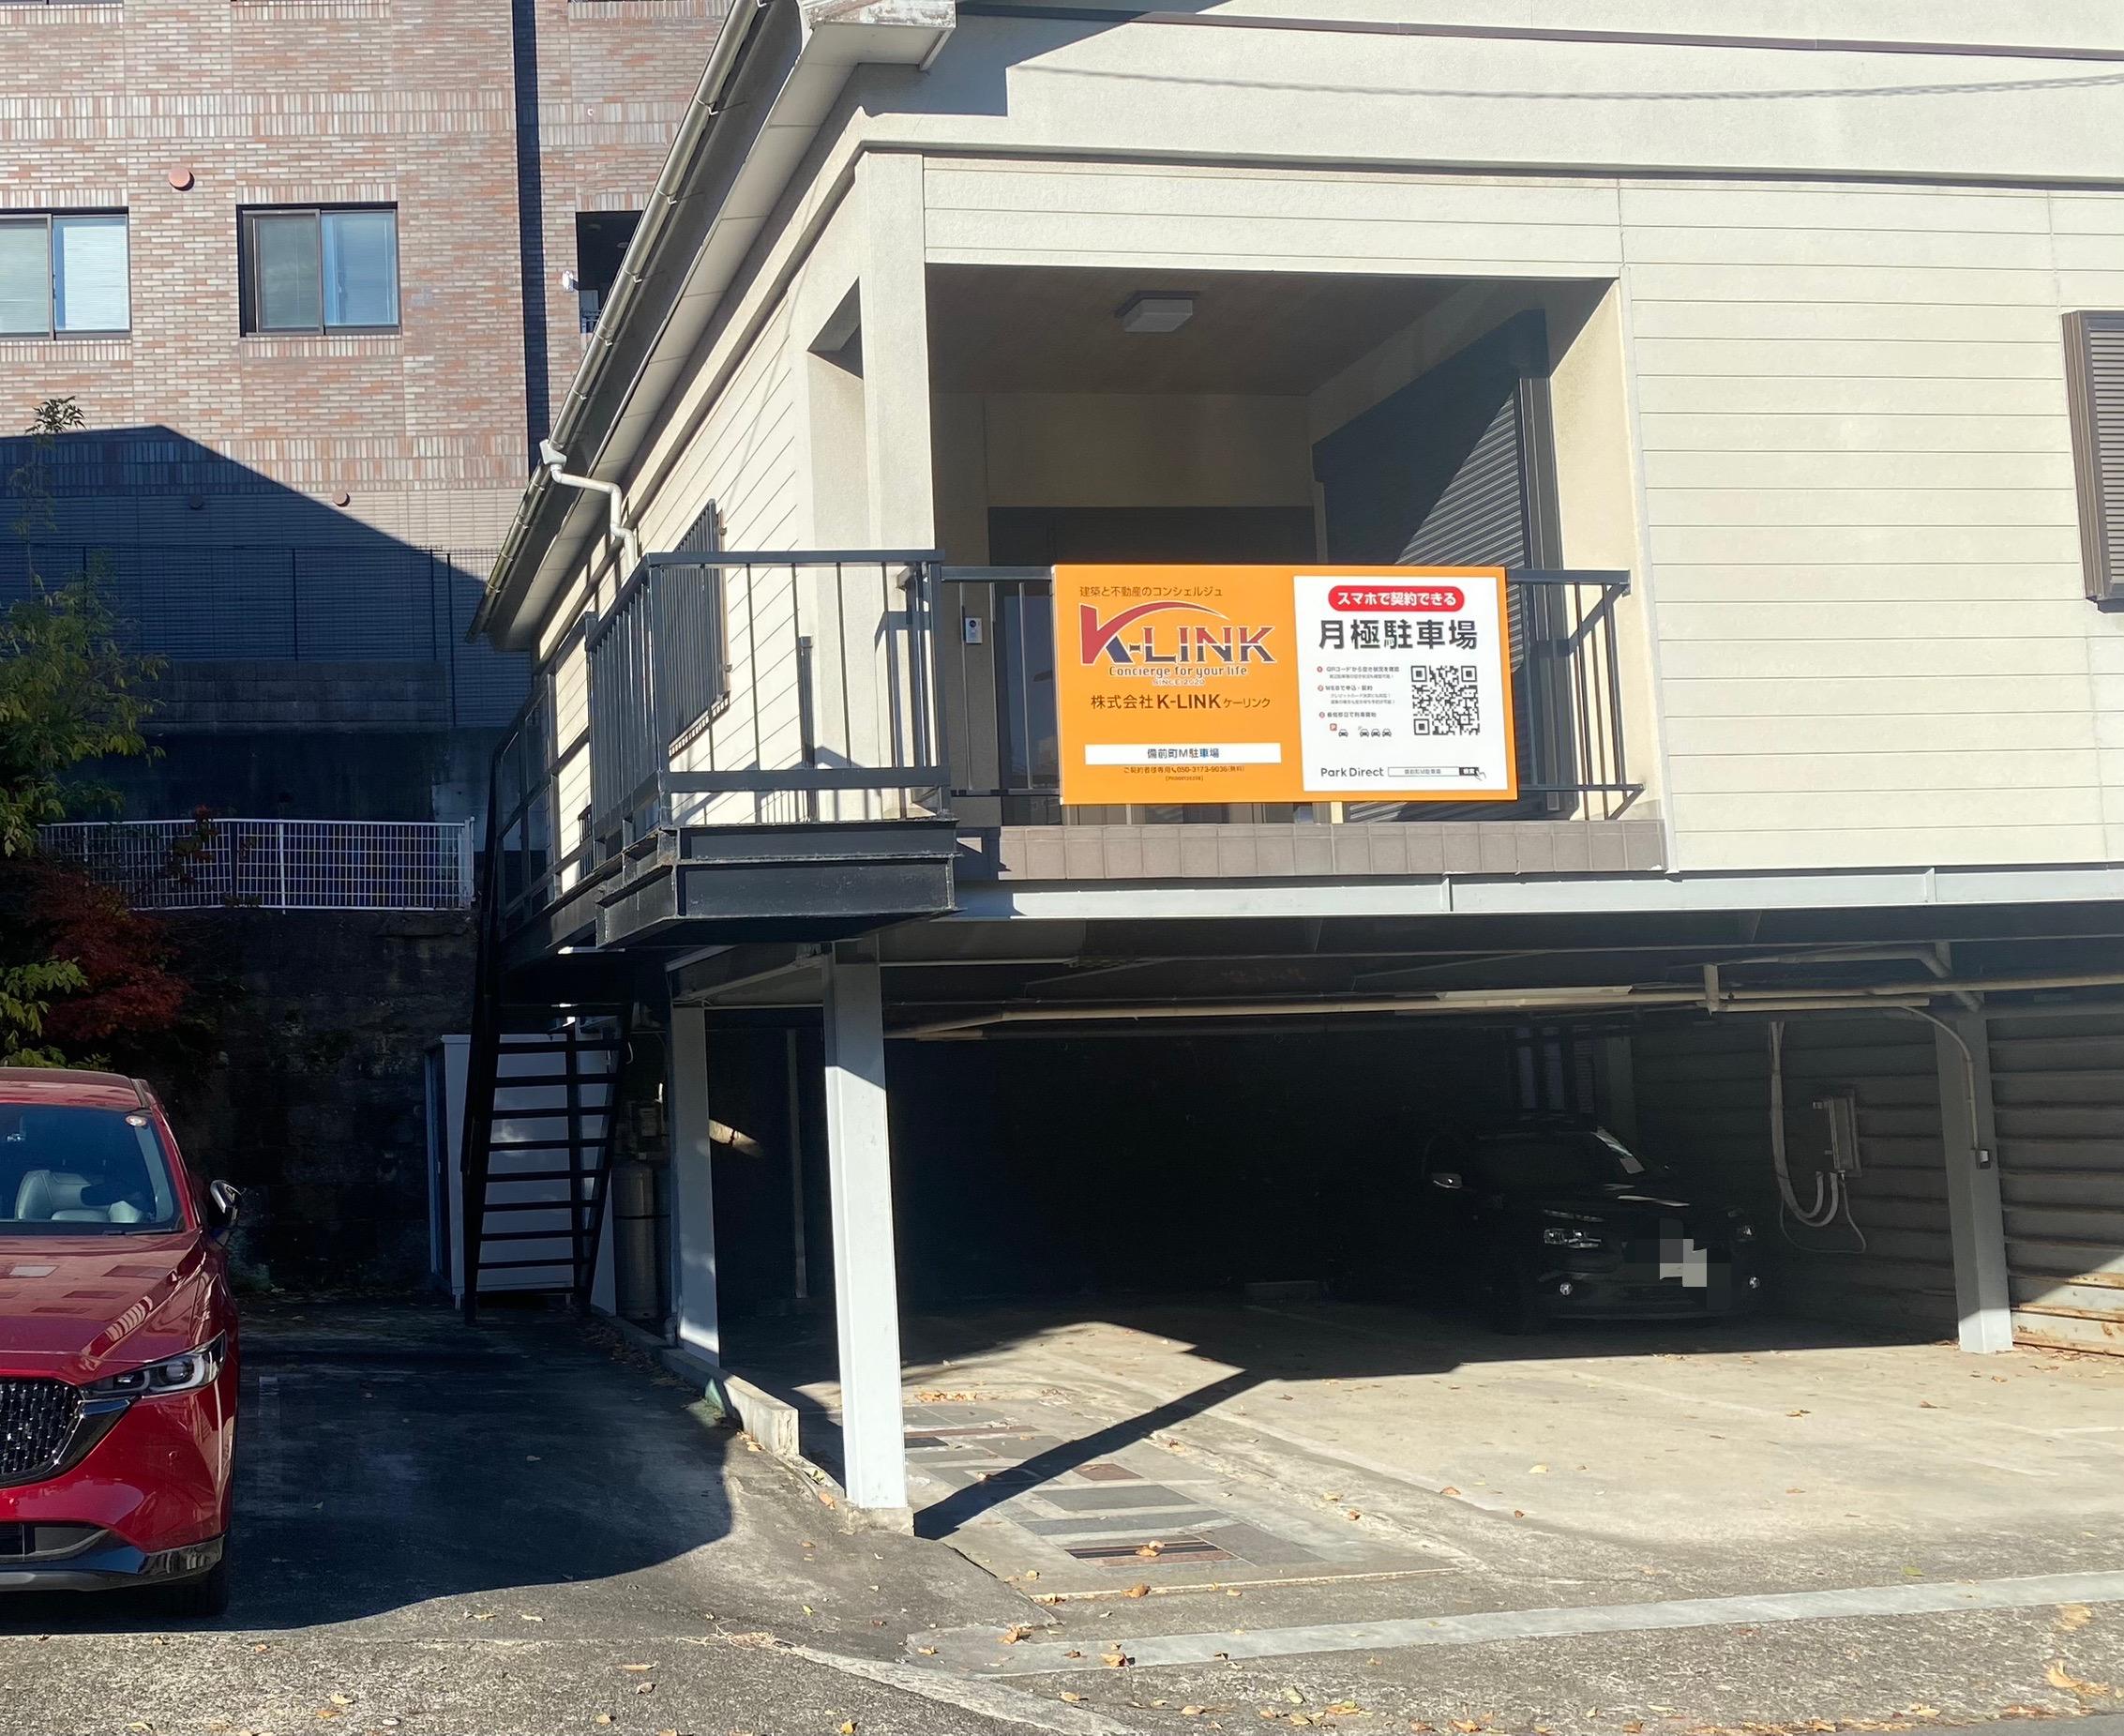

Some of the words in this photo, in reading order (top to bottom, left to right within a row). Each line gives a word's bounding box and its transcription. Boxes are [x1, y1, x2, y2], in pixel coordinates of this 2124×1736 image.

[1337, 592, 1457, 606] スマホで契約できる
[1078, 600, 1277, 665] K-LINK
[1318, 619, 1478, 650] 月極駐車場
[1109, 666, 1170, 677] Concierge
[1175, 666, 1191, 675] for
[1196, 667, 1225, 677] your
[1228, 666, 1247, 675] life
[1091, 694, 1153, 709] 株式会社
[1157, 694, 1221, 709] K-LINK
[1223, 698, 1271, 708] ケーリンク
[1320, 767, 1347, 777] Park
[1349, 767, 1384, 777] Direct
